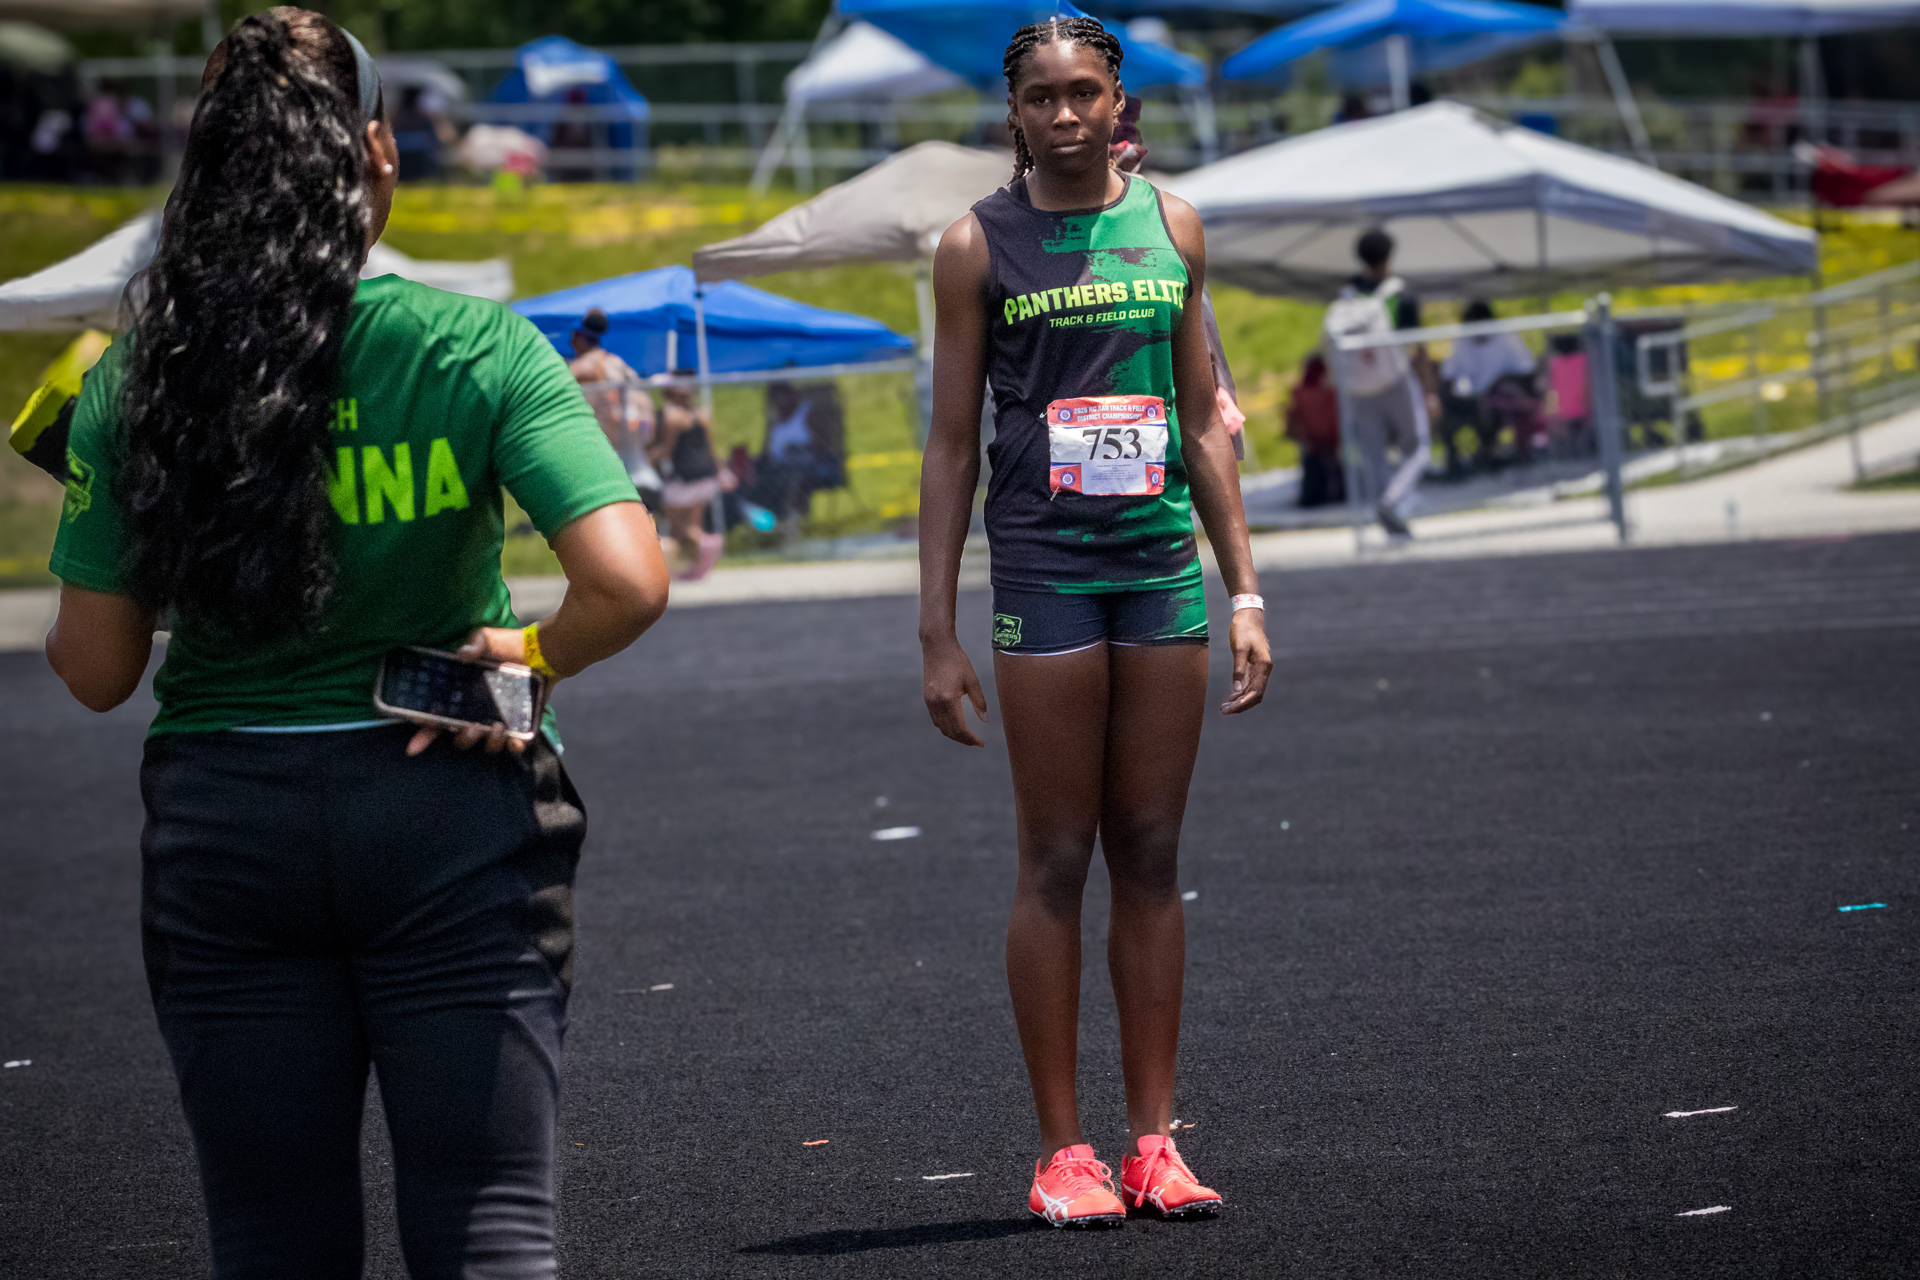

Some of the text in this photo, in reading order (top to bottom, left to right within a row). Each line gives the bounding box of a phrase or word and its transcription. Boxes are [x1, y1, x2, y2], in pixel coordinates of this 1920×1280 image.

[1004, 282, 1128, 325] PANTHERS
[1050, 308, 1155, 328] TRACK & FIELD CLUB
[1077, 413, 1100, 421] DISTRICT
[1082, 428, 1142, 460] 753
